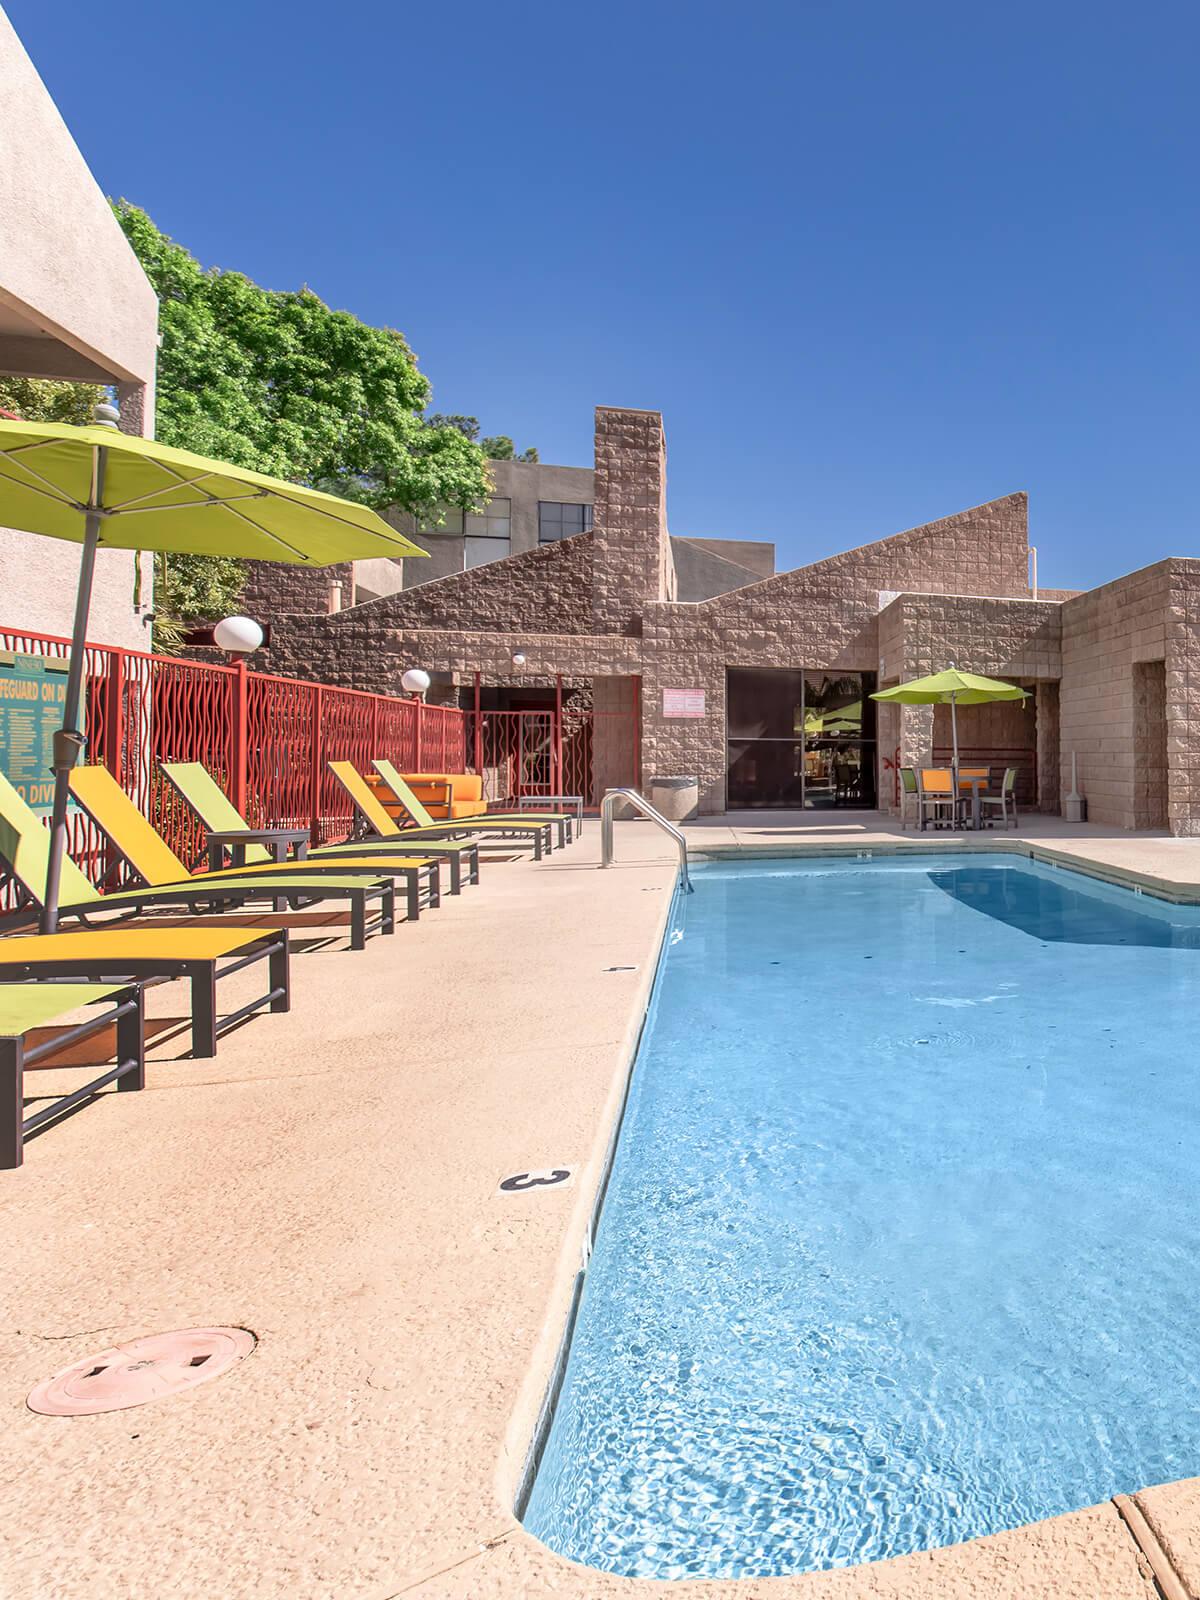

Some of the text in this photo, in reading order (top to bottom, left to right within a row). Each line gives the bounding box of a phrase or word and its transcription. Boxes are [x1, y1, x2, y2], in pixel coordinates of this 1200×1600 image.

[41, 682, 55, 702] ON
[57, 684, 67, 703] D
[16, 784, 56, 803] O DIVI
[500, 1170, 571, 1191] 3
